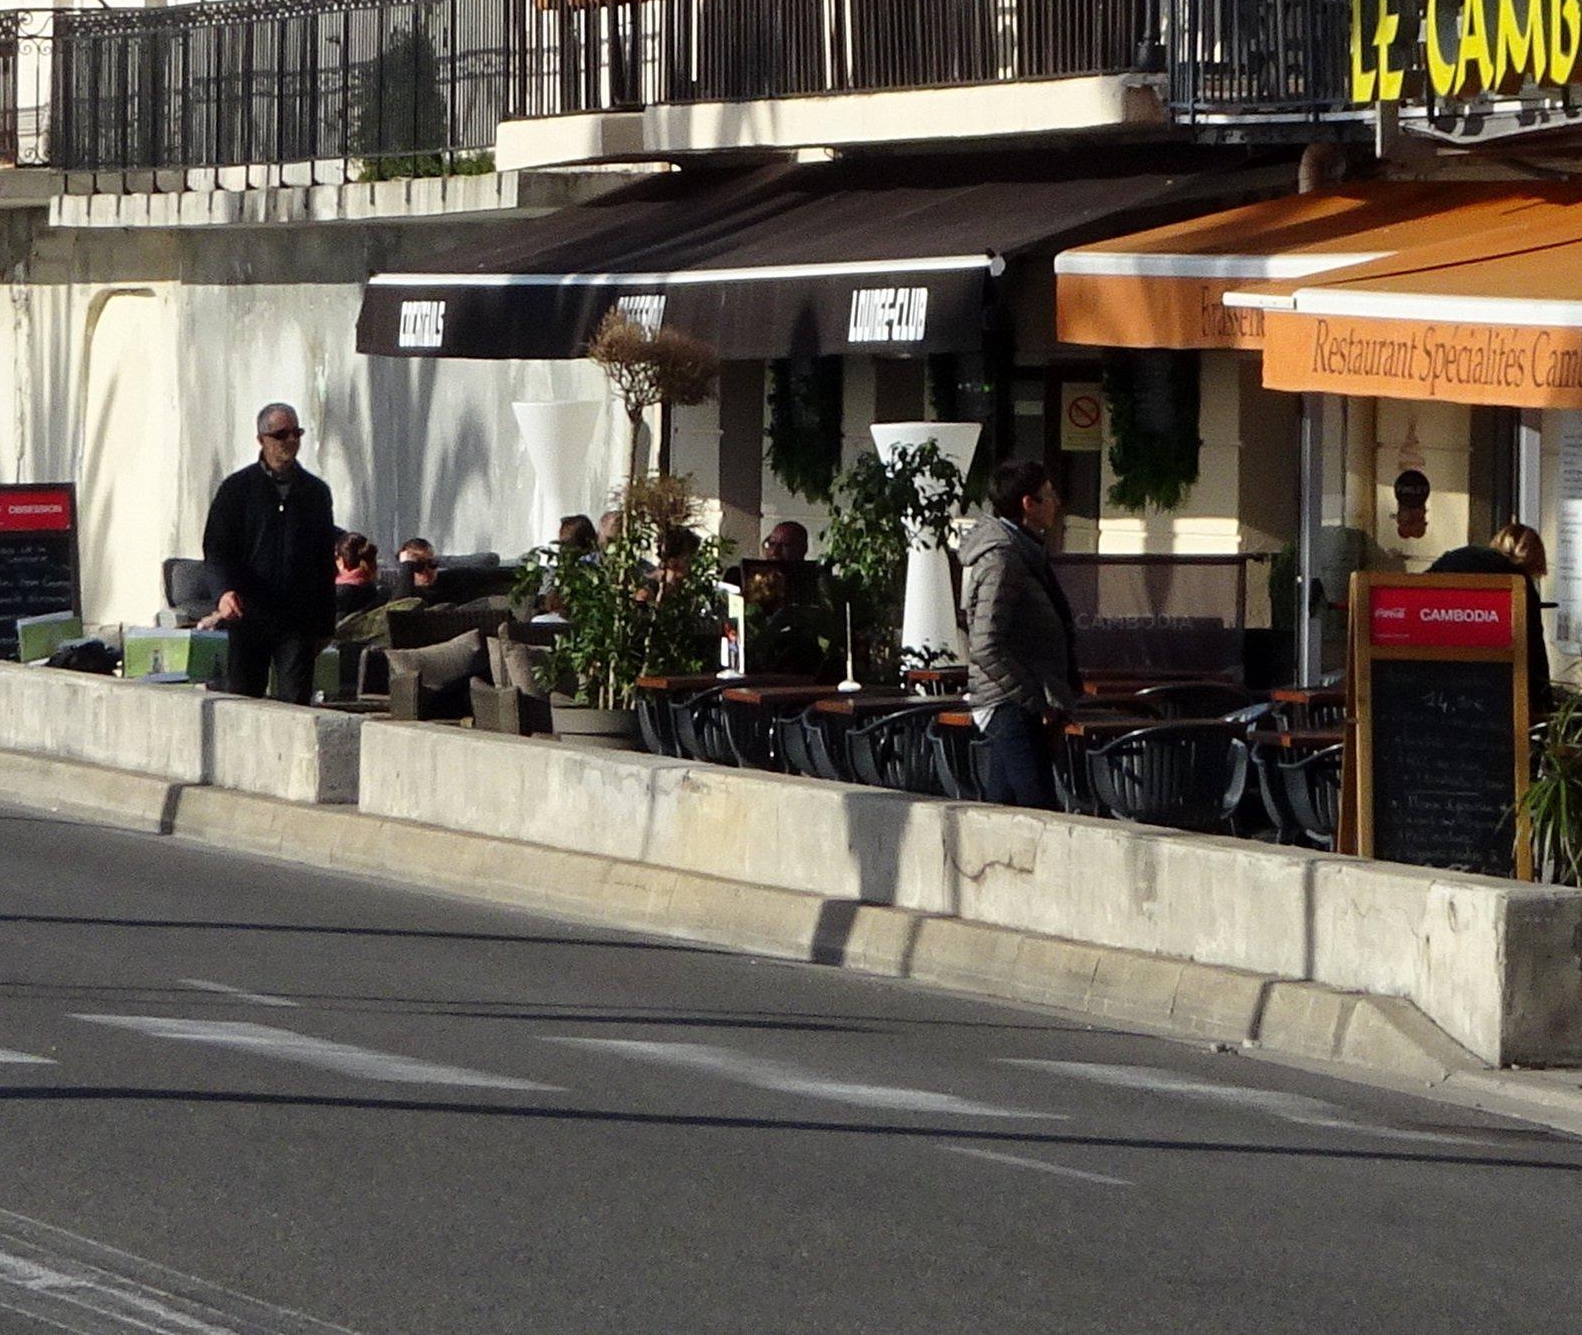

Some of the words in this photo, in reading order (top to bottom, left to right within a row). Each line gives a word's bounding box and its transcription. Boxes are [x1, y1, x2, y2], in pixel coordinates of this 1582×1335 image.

[1313, 318, 1418, 379] Restaurant
[1418, 324, 1525, 395] Spécialités
[8, 504, 63, 515] OBSESSION
[1420, 608, 1500, 623] CAMBODIA
